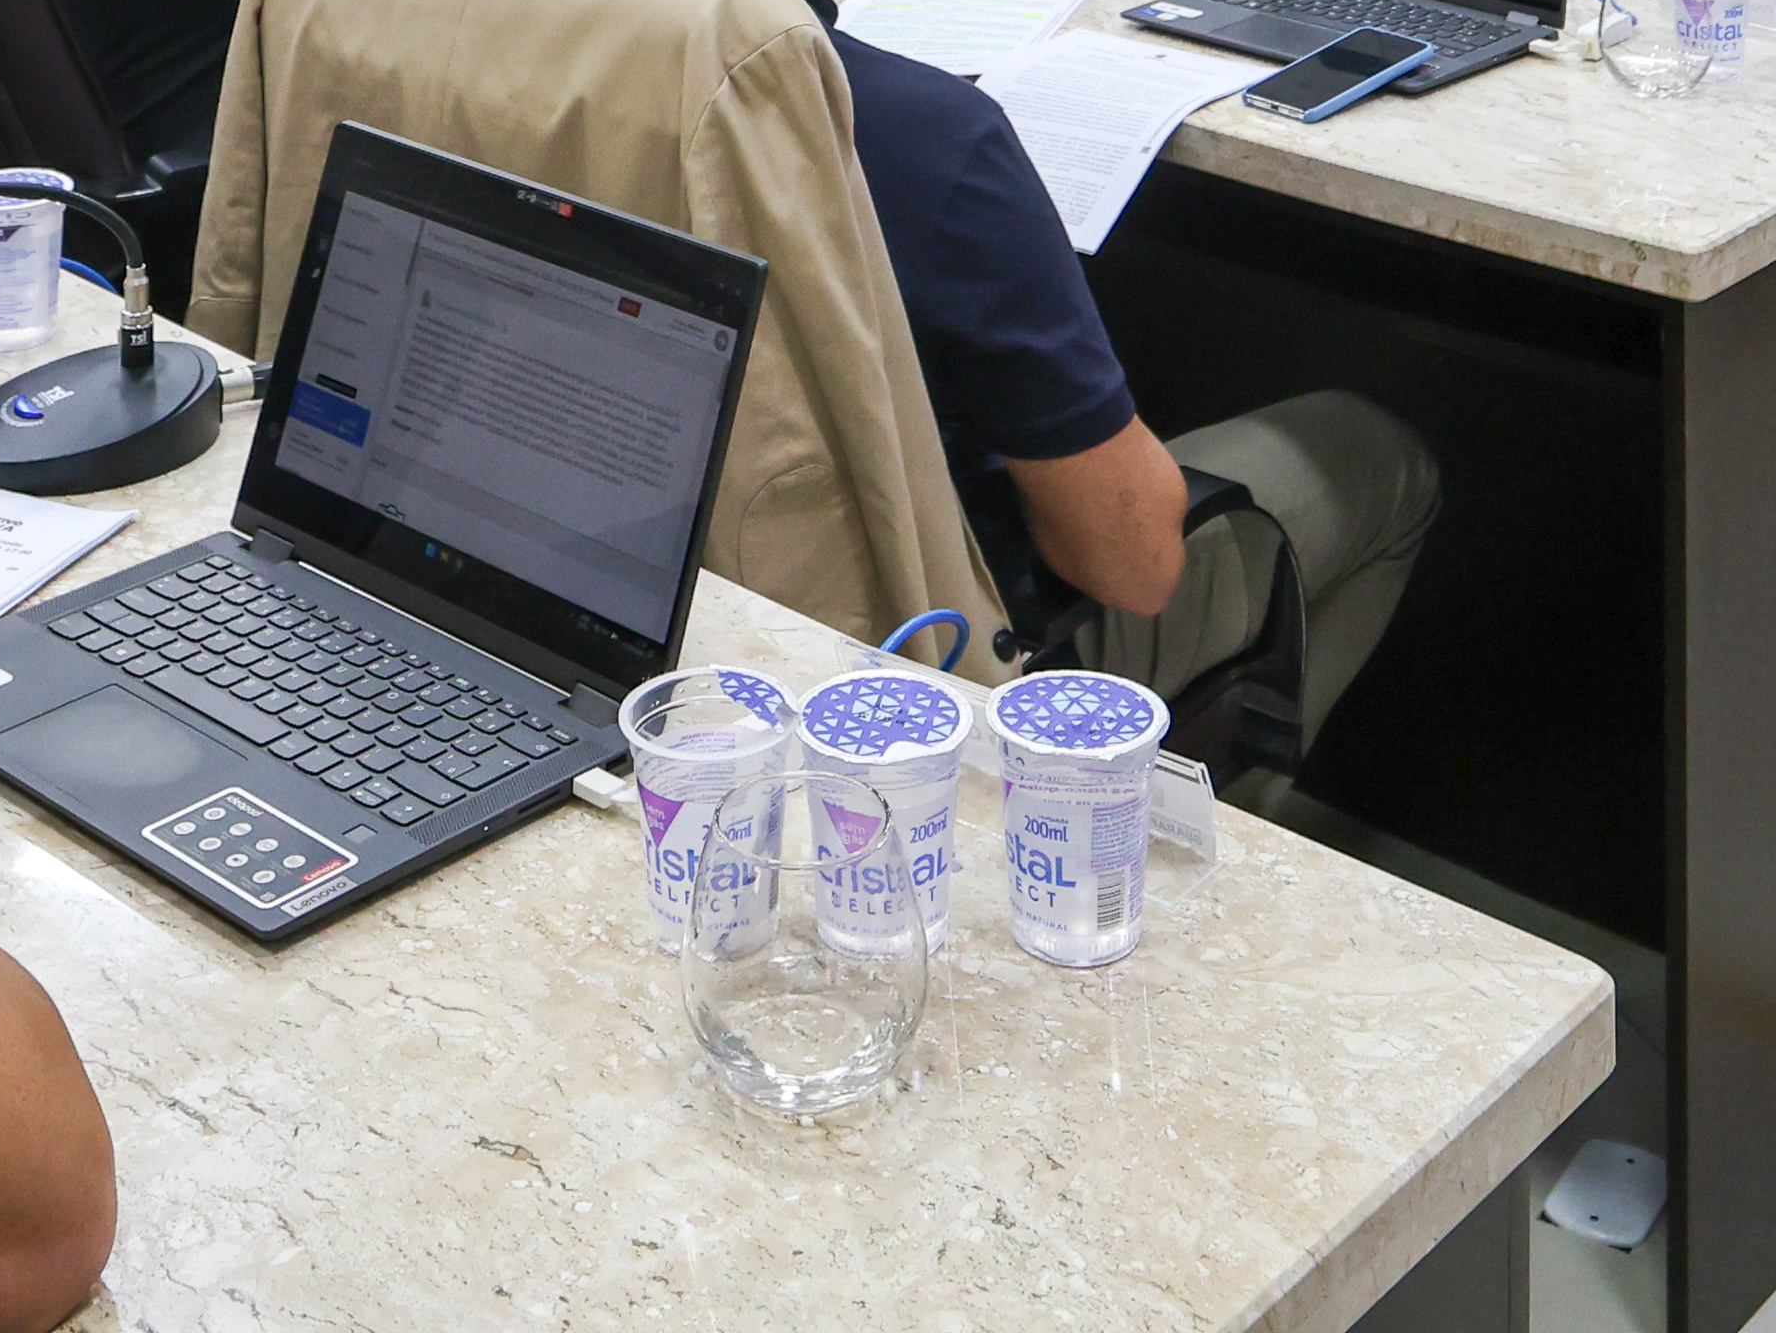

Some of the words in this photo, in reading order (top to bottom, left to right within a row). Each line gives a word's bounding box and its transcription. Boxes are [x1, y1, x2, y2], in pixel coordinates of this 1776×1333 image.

[910, 814, 948, 844] 200ml
[1024, 815, 1069, 843] 200ml
[290, 882, 347, 912] Lenovo
